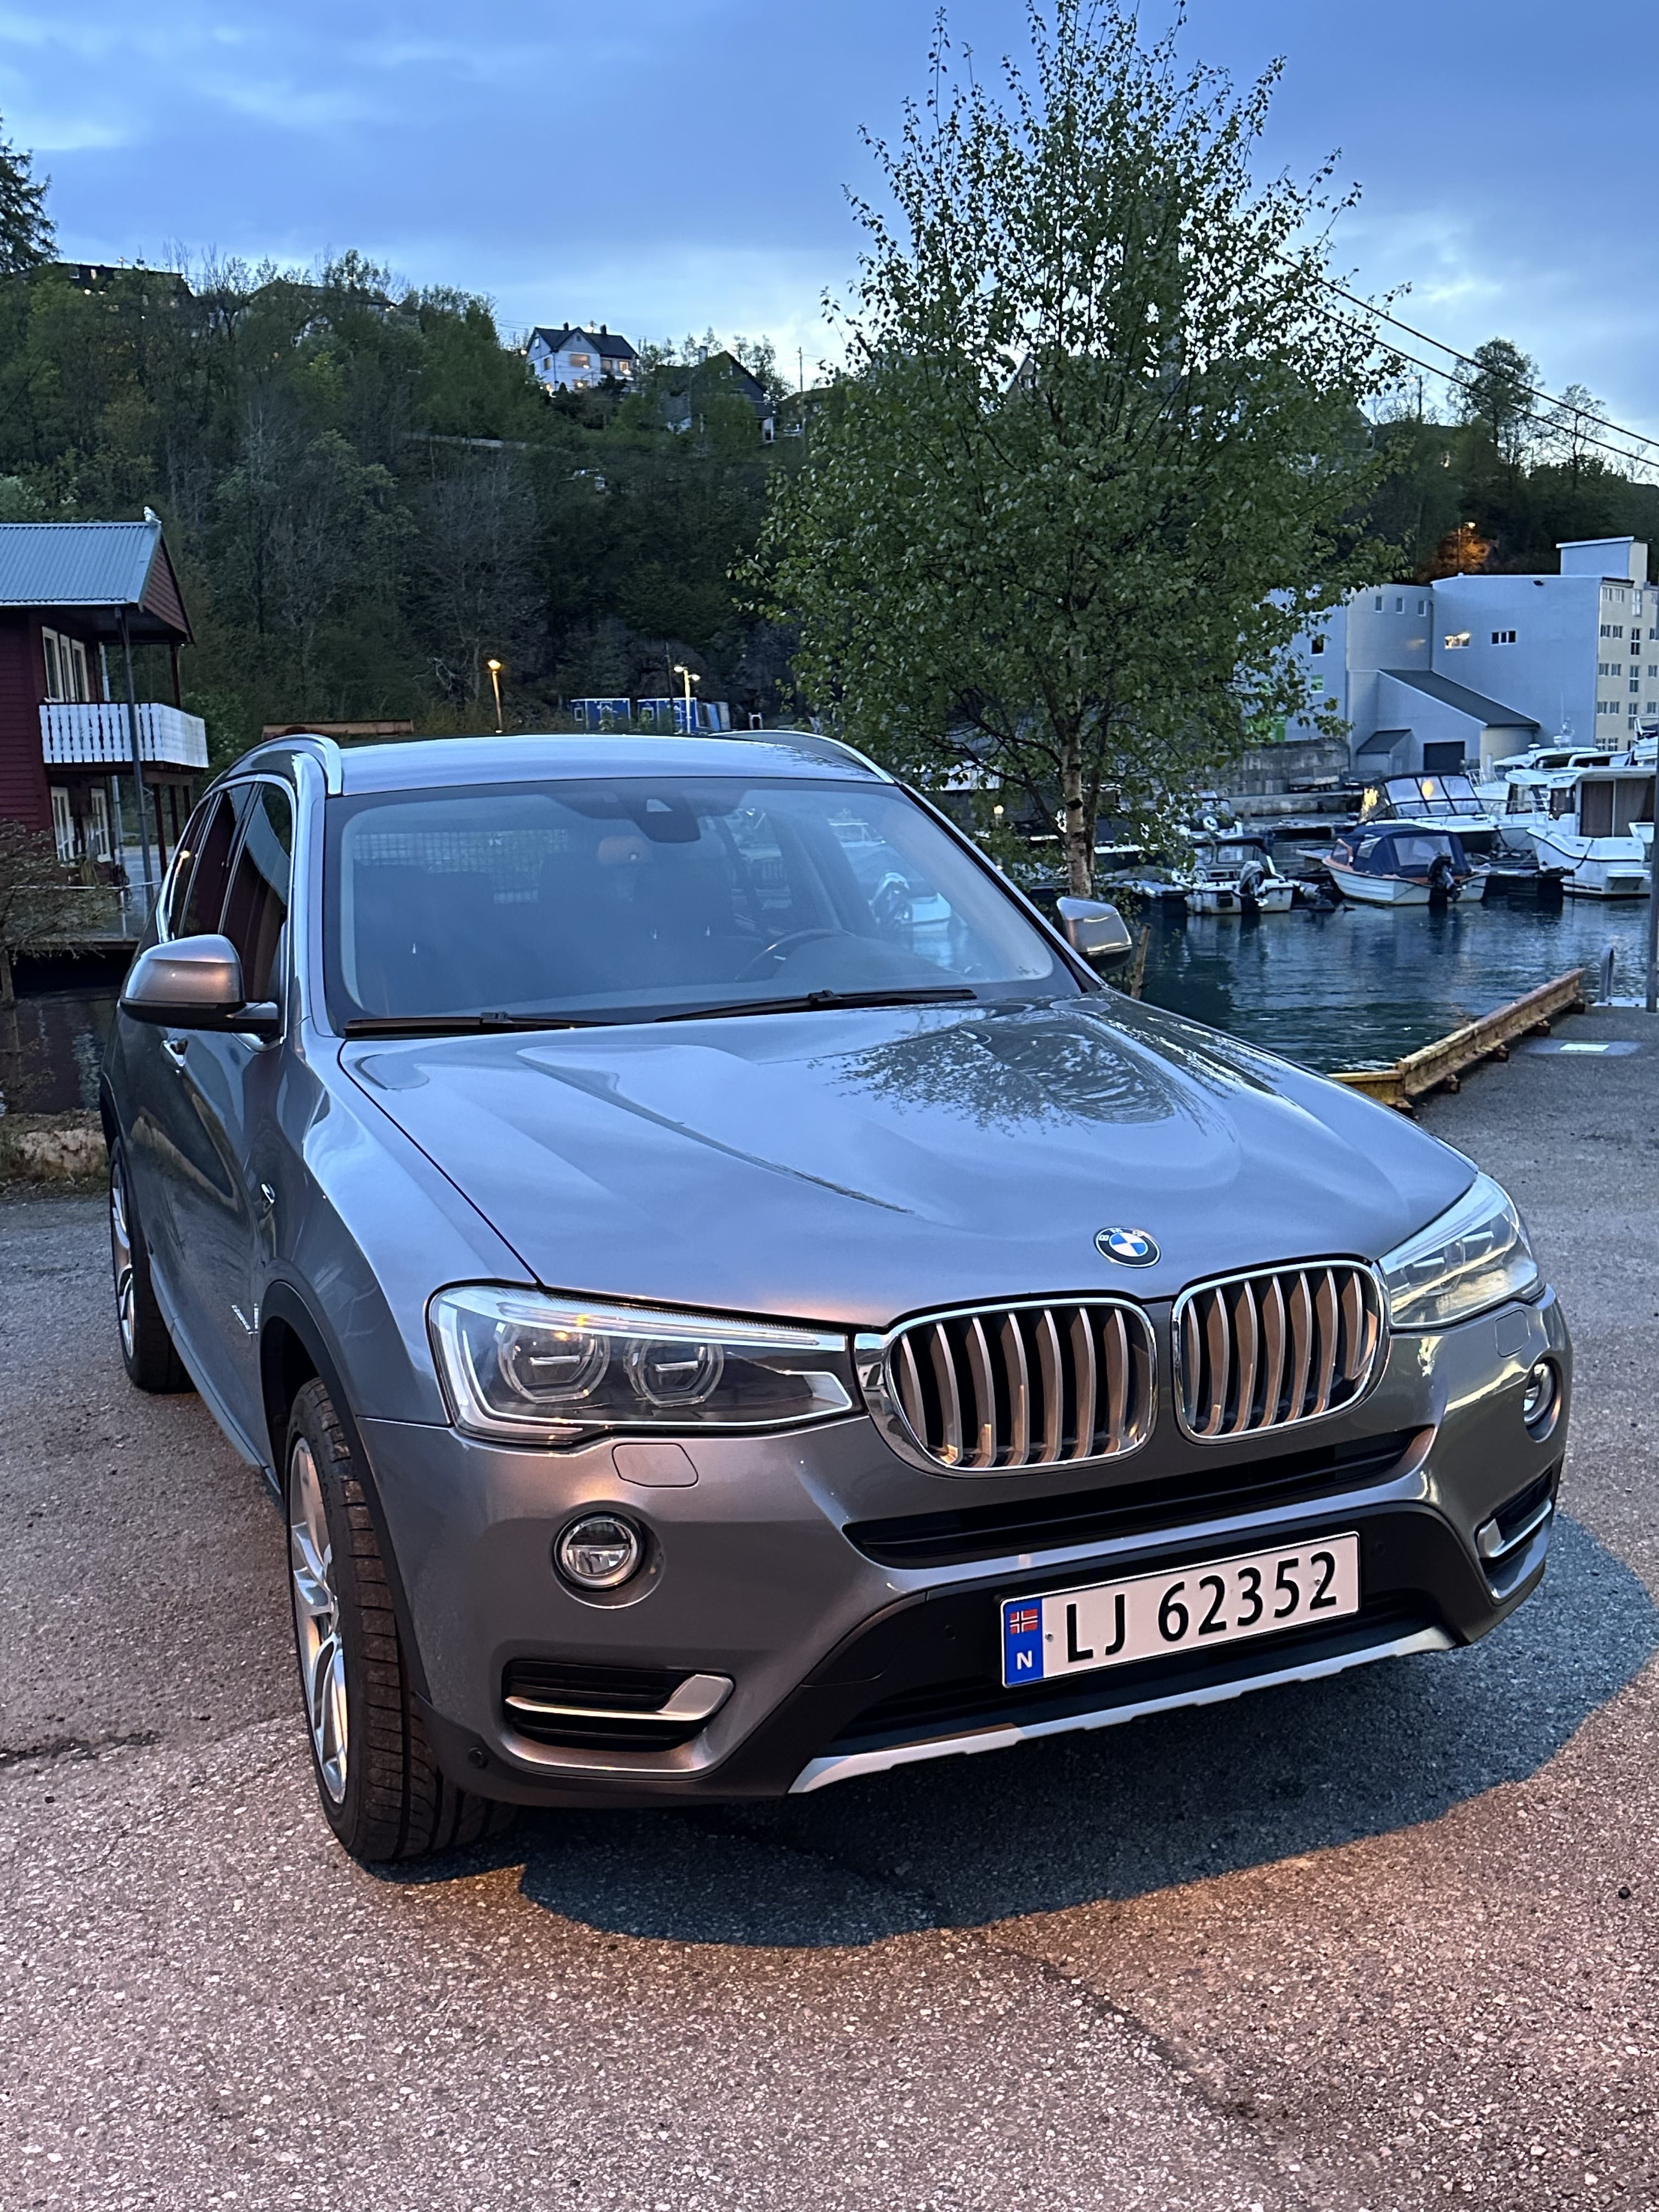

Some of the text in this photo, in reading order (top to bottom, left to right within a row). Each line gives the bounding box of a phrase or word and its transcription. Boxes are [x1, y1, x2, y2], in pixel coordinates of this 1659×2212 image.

[1066, 1551, 1337, 1663] LJ 62352
[1017, 1650, 1032, 1670] N
